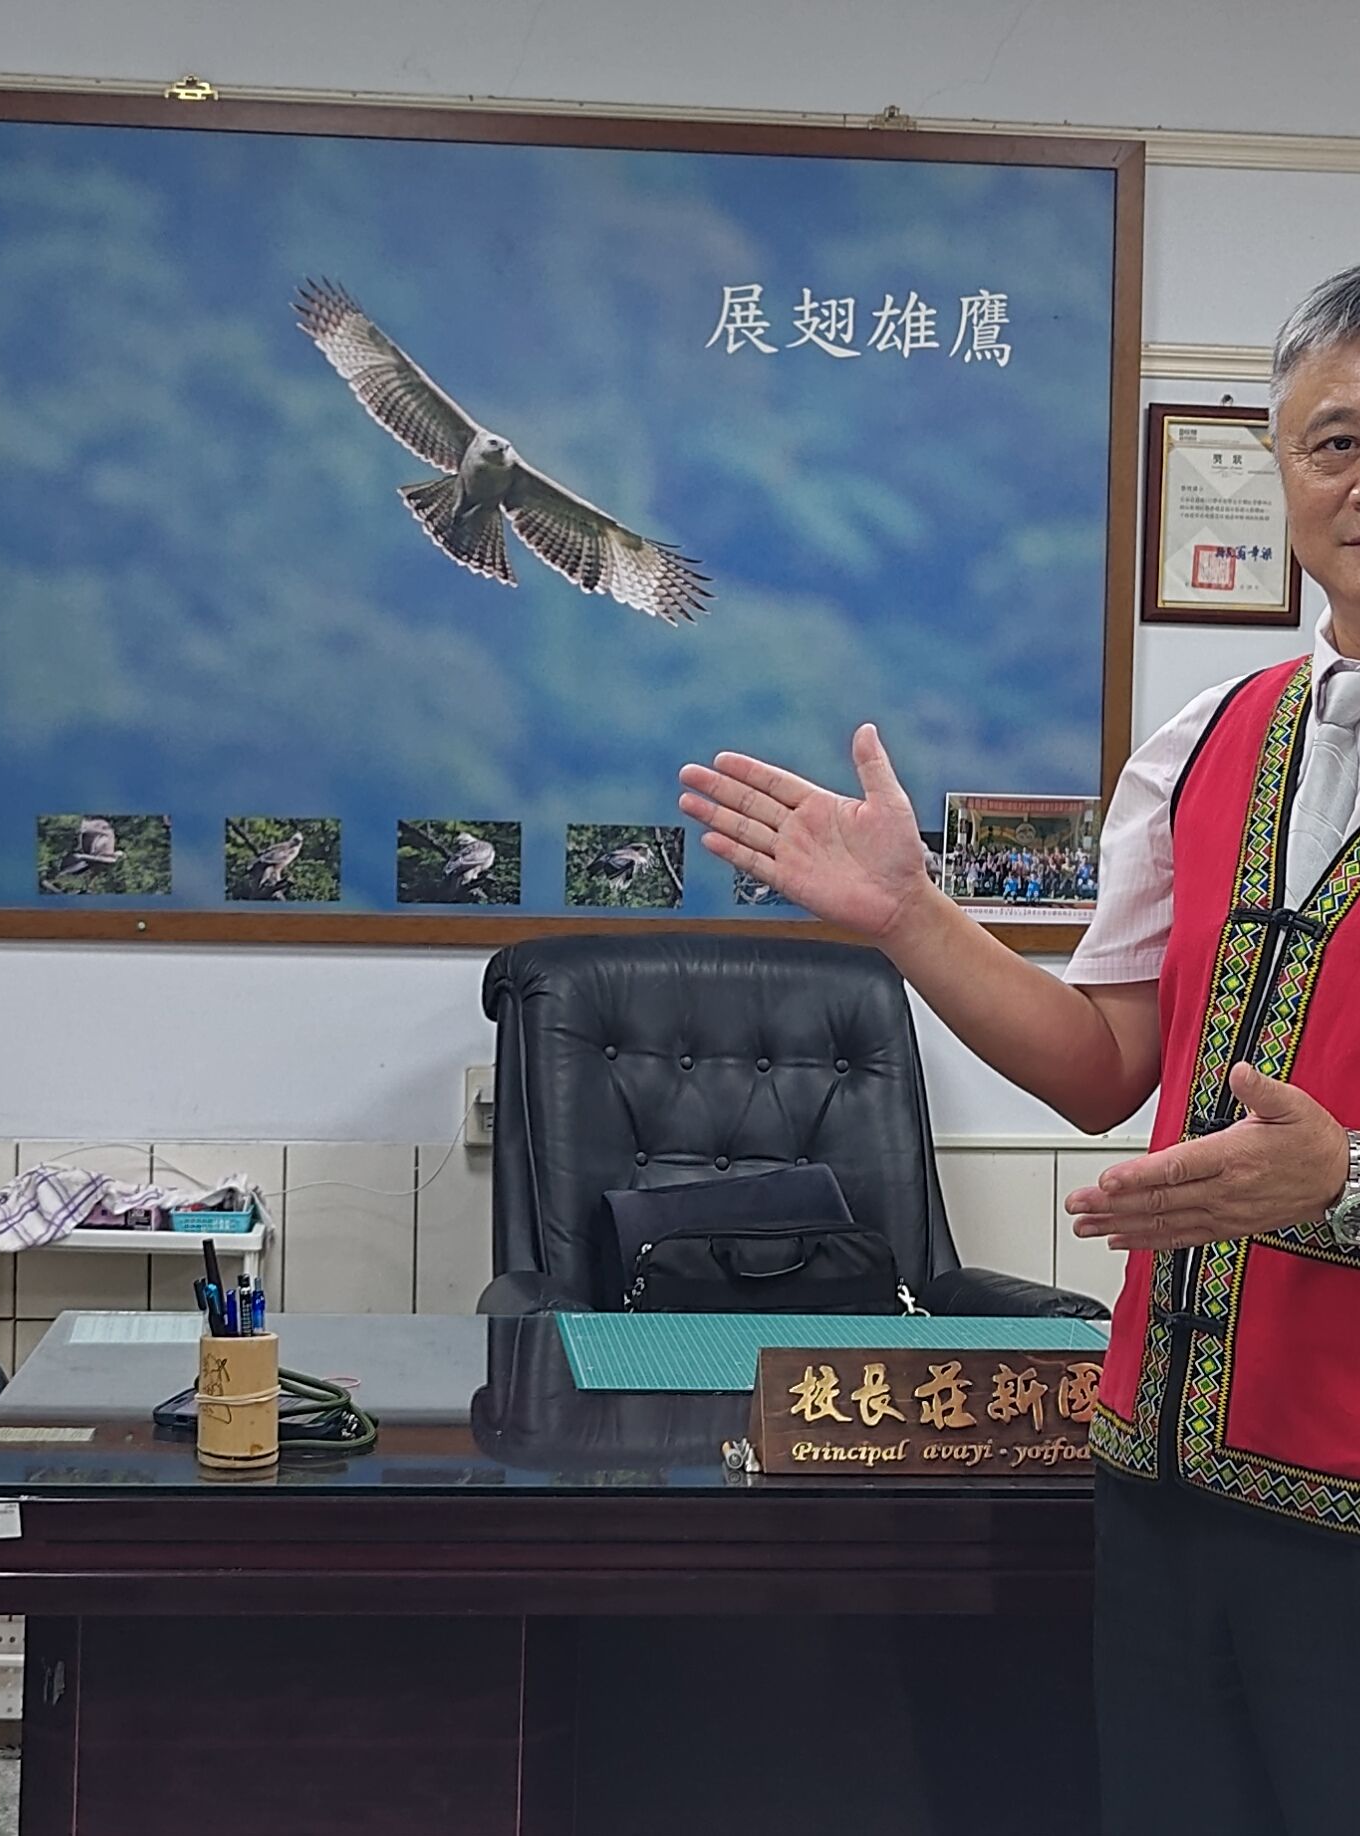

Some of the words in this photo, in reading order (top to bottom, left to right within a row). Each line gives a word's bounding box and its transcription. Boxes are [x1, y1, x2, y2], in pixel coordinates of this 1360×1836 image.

[705, 284, 1012, 368] 展翅雄鷹
[791, 1439, 907, 1467] Principal
